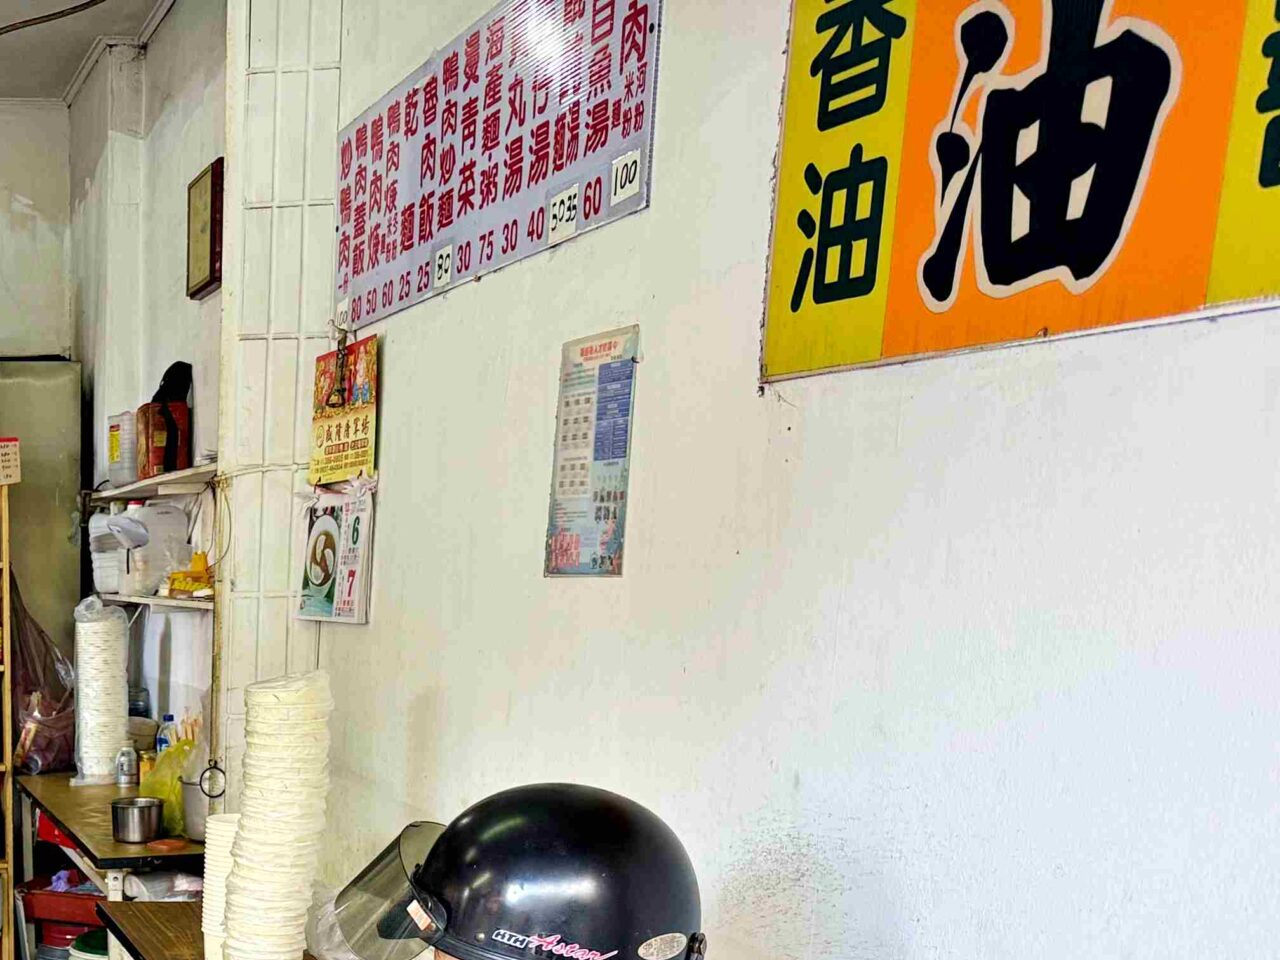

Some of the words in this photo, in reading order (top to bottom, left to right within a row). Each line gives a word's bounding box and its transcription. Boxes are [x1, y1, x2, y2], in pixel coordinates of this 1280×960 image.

[501, 0, 530, 202] 丸湯
[436, 50, 459, 232] 鴨肉炒麵
[790, 0, 907, 313] 香油
[919, 0, 1178, 308] 油
[352, 123, 368, 278] 鴨肉蓋飯
[583, 176, 602, 221] 60
[479, 223, 494, 265] 75
[501, 220, 518, 255] 30
[527, 207, 545, 243] 40
[456, 241, 471, 274] 30
[382, 279, 394, 309] 60
[398, 271, 411, 302] 25
[417, 262, 430, 293] 25
[366, 287, 377, 316] 50
